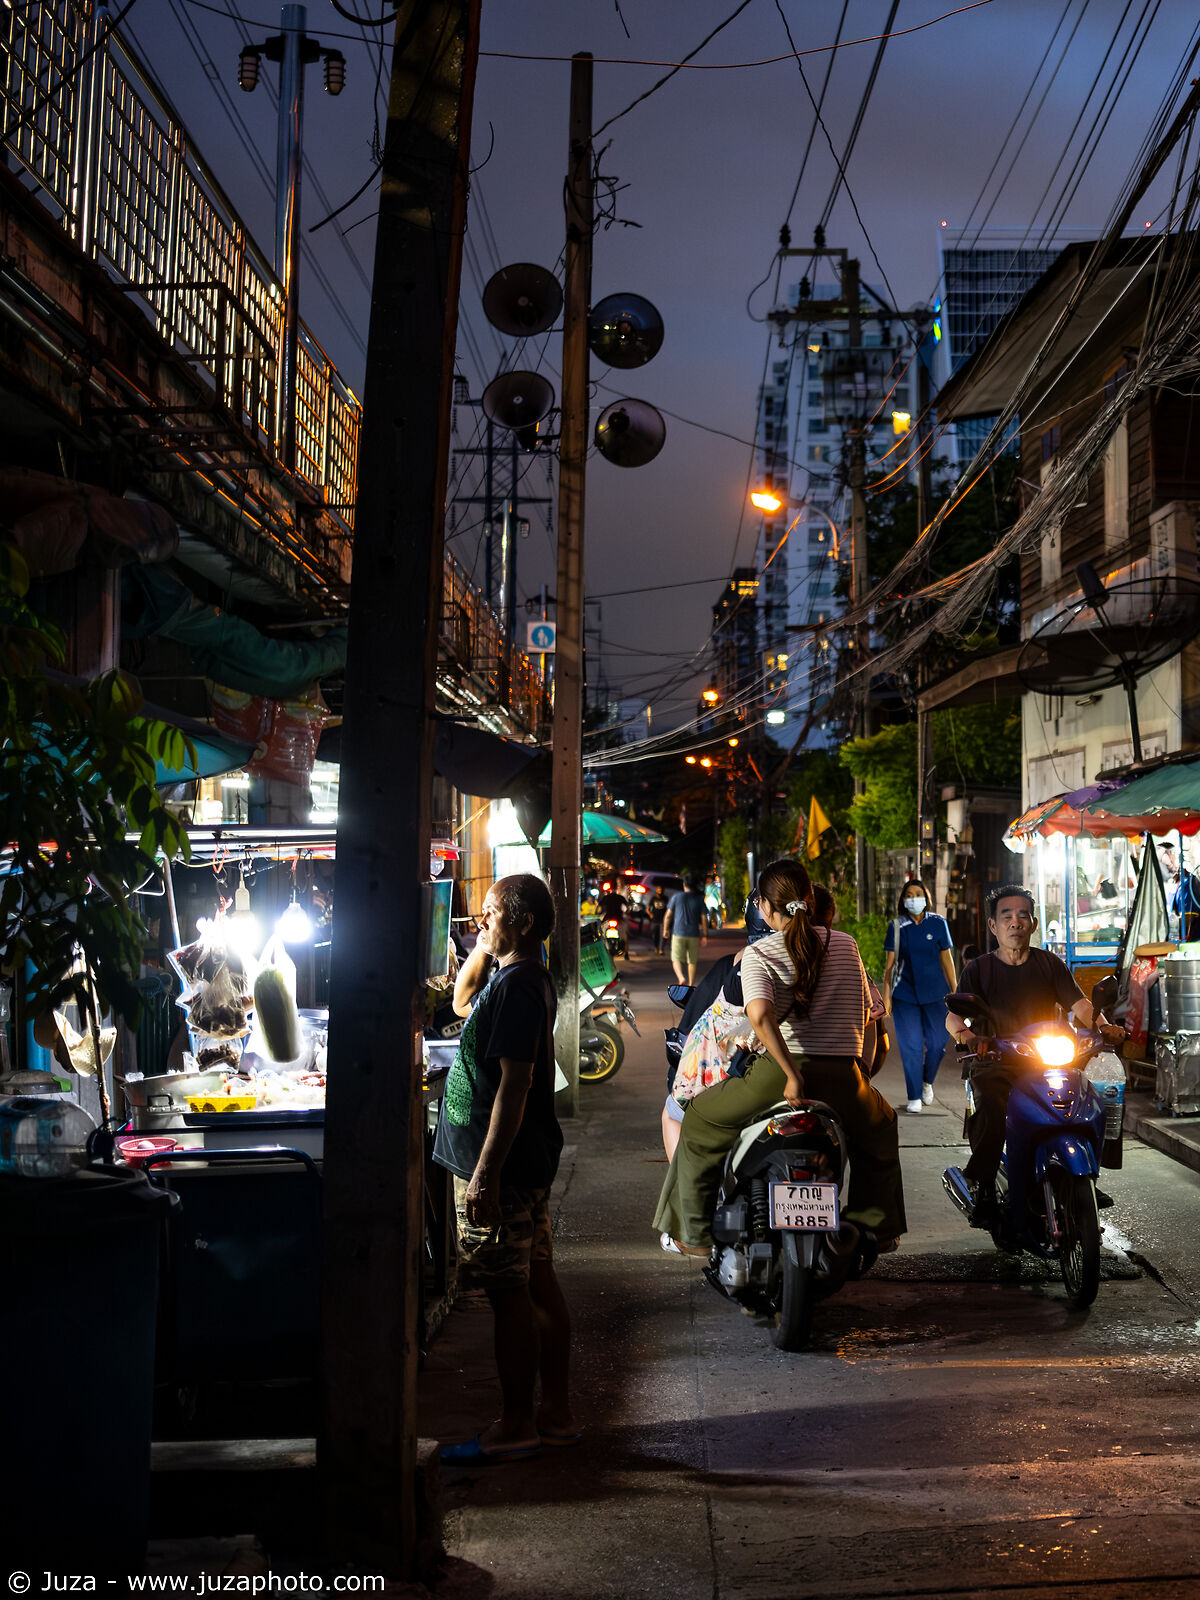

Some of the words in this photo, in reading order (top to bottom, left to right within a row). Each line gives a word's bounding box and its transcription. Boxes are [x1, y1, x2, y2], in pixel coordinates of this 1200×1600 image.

[776, 1203, 834, 1212] กรุงเทพมหานคร
[784, 1215, 828, 1227] 1885
